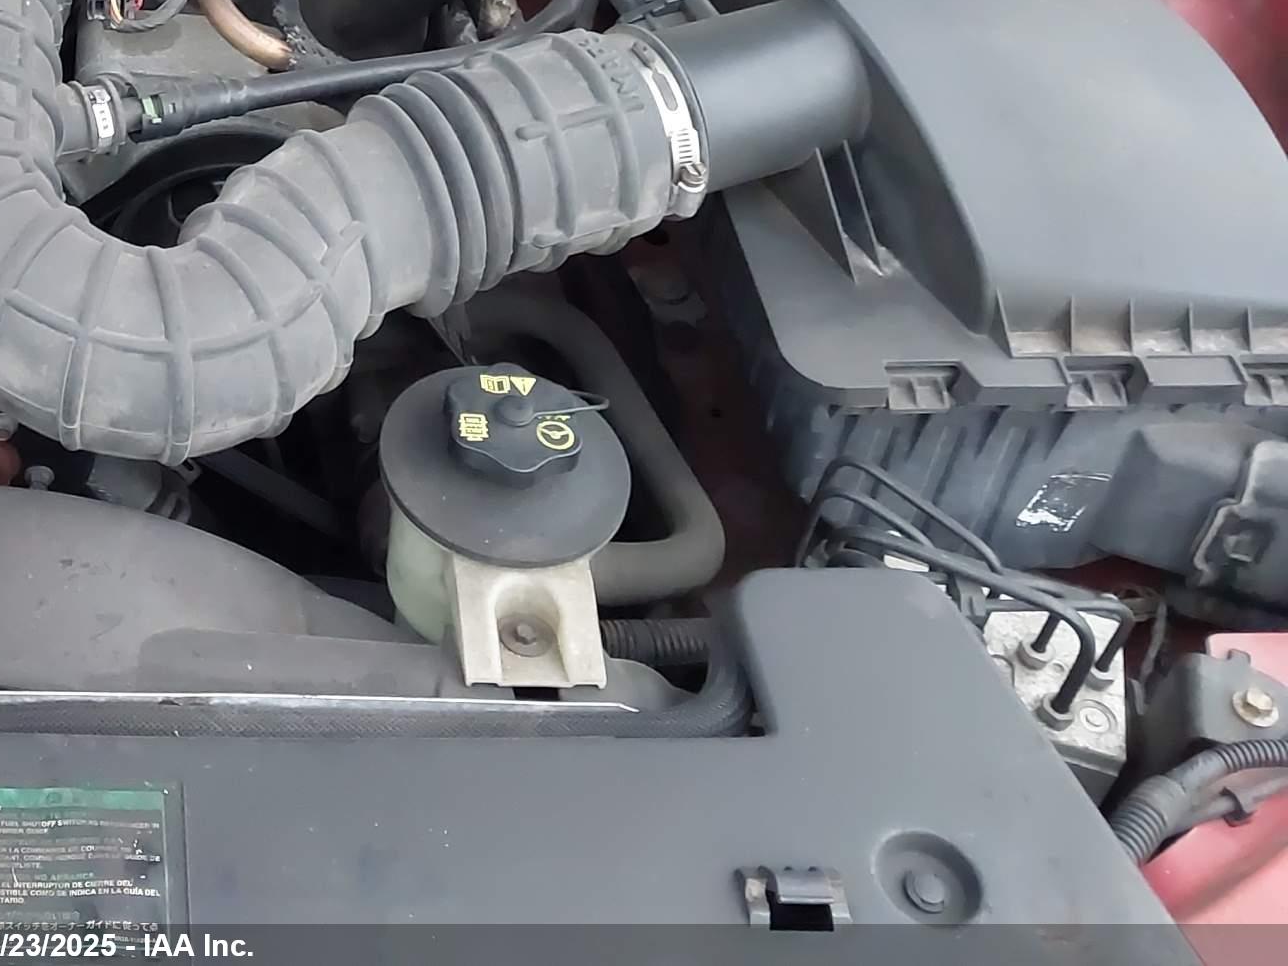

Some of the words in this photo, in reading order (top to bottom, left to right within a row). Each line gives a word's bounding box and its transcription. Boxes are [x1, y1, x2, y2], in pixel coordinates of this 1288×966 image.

[13, 881, 70, 889] INTERRUPTOR
[116, 879, 133, 887] DEL
[69, 888, 96, 896] INDICA
[145, 889, 160, 897] DEL
